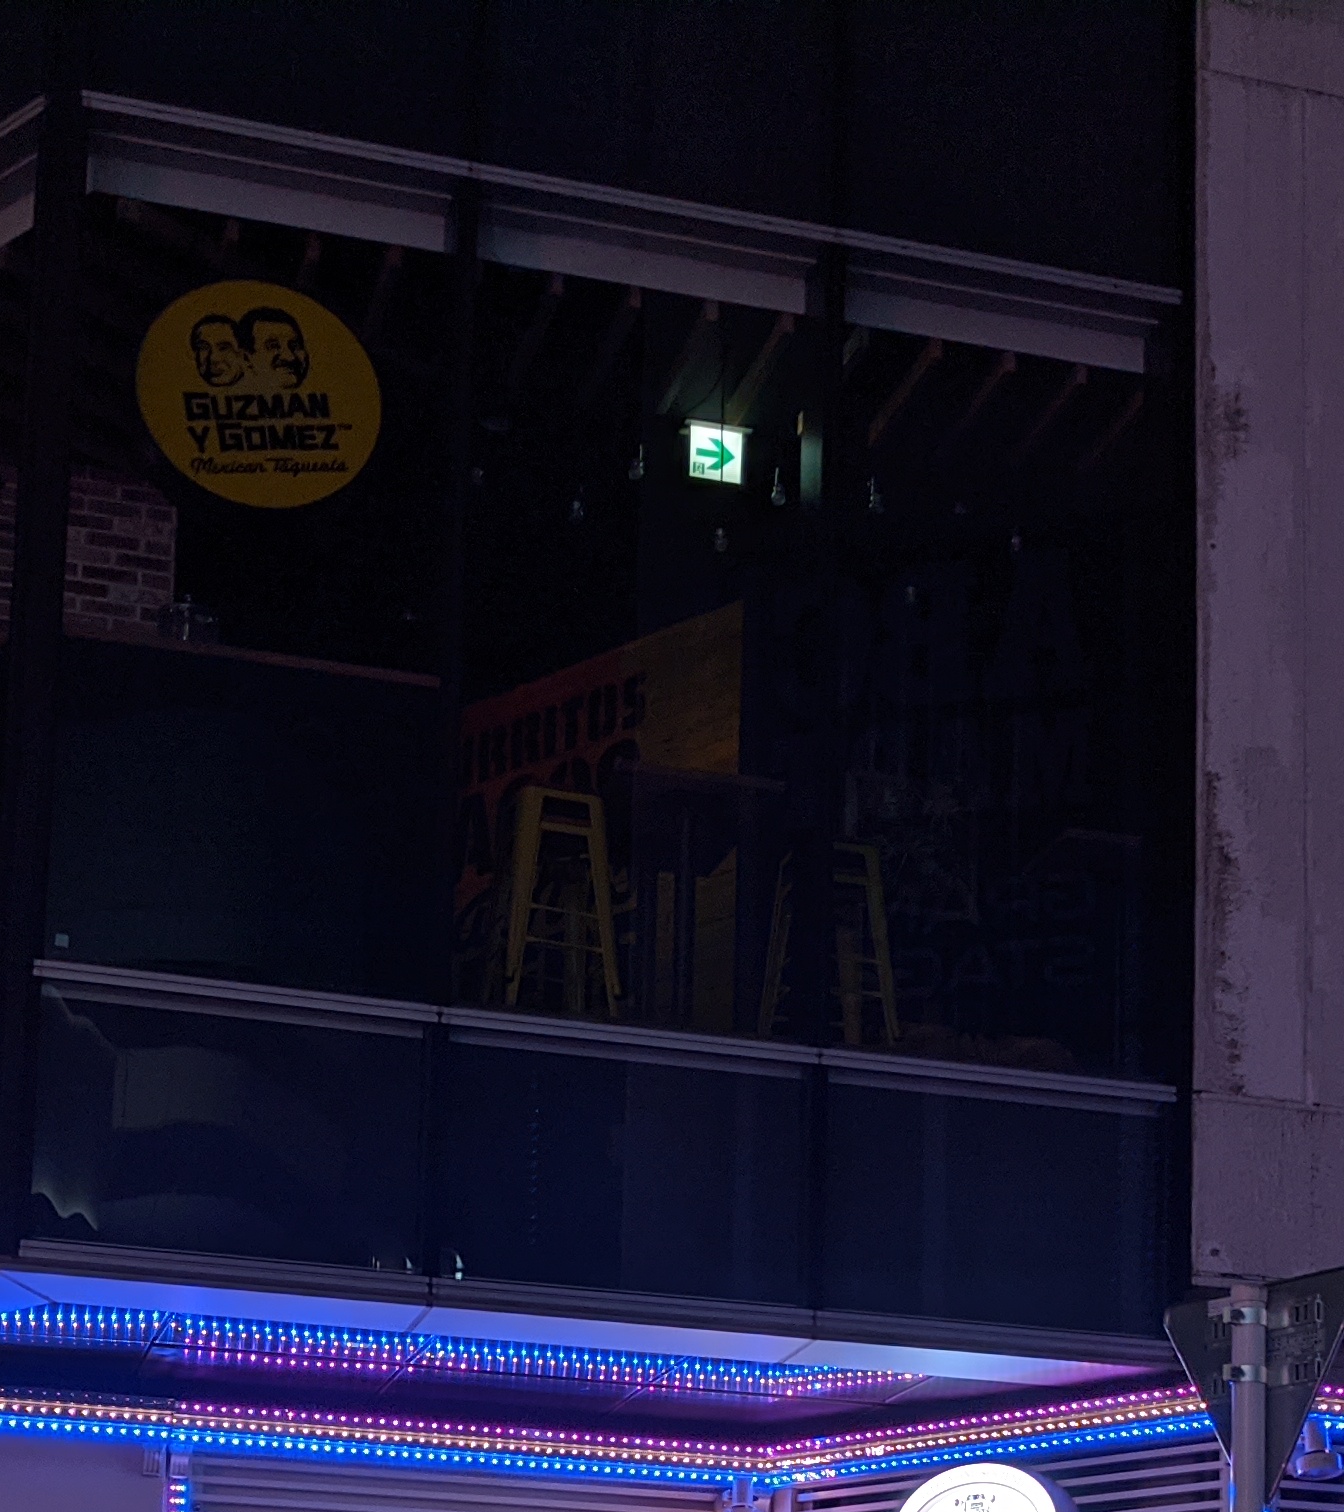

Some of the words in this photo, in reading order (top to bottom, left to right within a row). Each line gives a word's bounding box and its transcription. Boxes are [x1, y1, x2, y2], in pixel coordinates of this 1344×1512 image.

[183, 391, 331, 421] GUZMAN
[187, 426, 210, 453] Y
[217, 422, 339, 451] GOMEZ
[190, 457, 267, 475] Mexican
